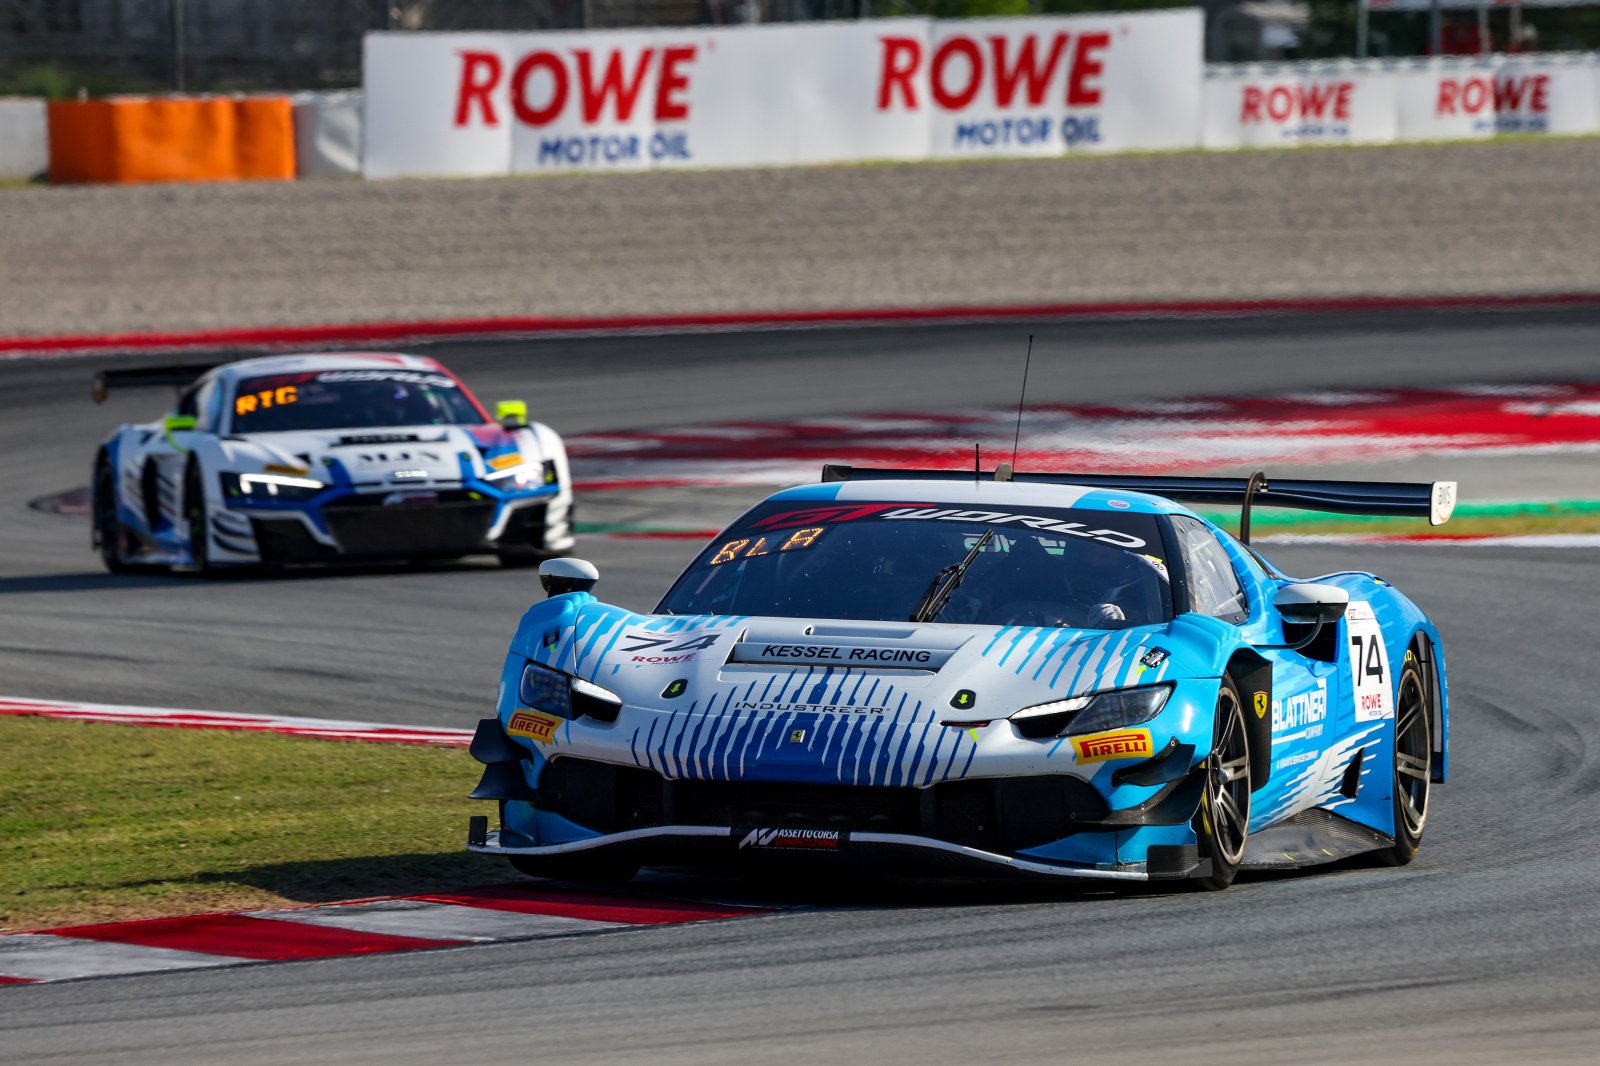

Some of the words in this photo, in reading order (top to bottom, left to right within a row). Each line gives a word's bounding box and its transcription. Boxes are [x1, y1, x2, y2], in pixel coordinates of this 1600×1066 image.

[454, 43, 697, 128] ROWE
[877, 31, 1111, 111] ROWE
[1241, 81, 1354, 124] ROWE
[1435, 74, 1550, 118] ROWE
[955, 118, 1052, 146] MOTOR
[1061, 115, 1102, 144] OIL
[537, 133, 639, 164] MOTOR
[649, 130, 692, 159] OIL
[749, 504, 936, 531] GT
[879, 508, 1147, 549] WORLD
[620, 634, 722, 652] 74
[631, 653, 697, 663] ROWE
[761, 644, 842, 660] KESSEL
[848, 647, 931, 663] RACING
[1351, 634, 1384, 687] 74
[734, 701, 884, 715] INDUSTREER
[1271, 689, 1327, 733] BLATTNER
[1361, 694, 1382, 711] ROWE
[509, 713, 556, 738] PIRELLI
[1079, 733, 1147, 759] PIRELLI
